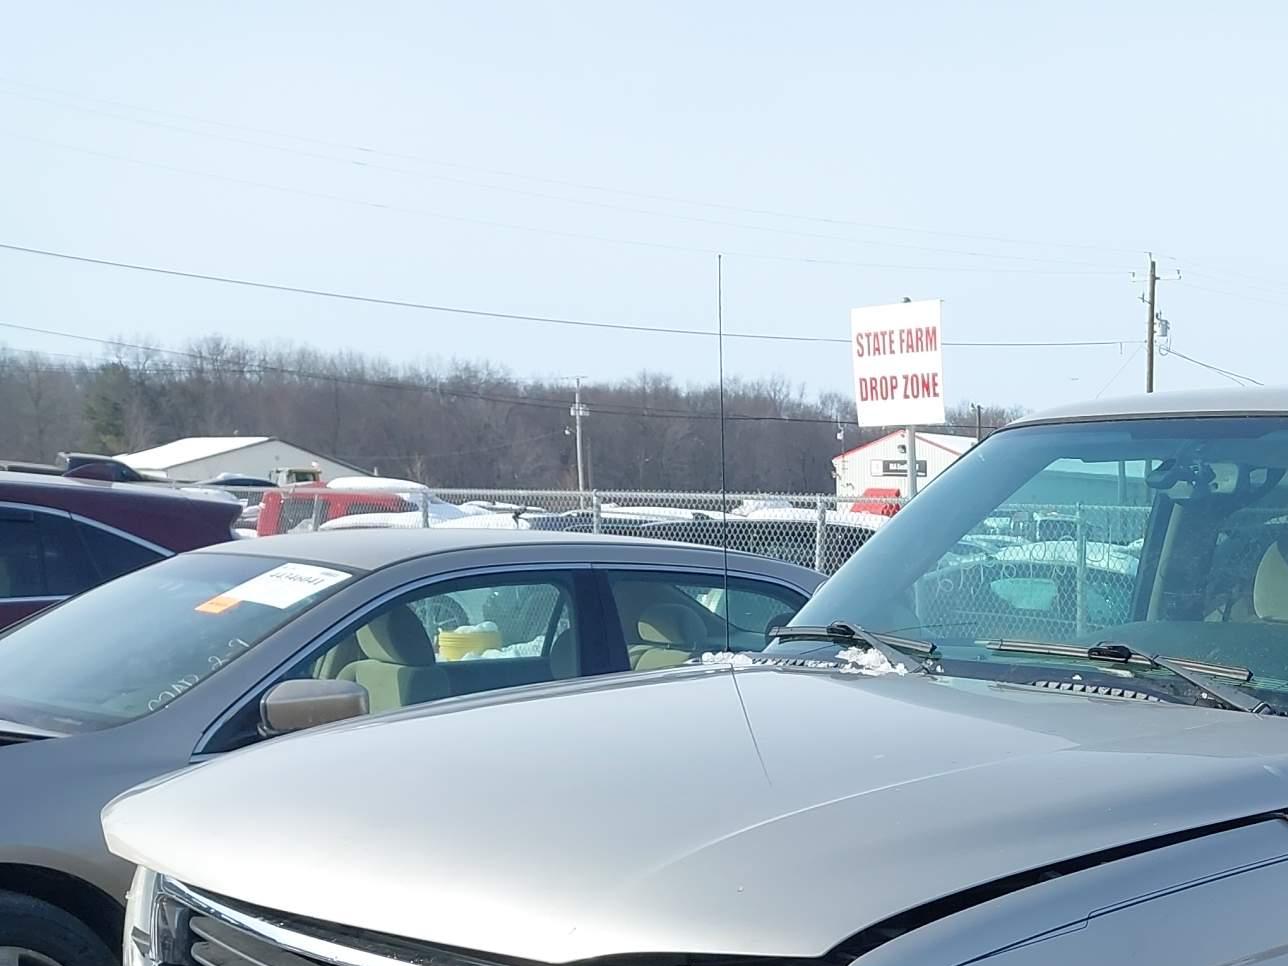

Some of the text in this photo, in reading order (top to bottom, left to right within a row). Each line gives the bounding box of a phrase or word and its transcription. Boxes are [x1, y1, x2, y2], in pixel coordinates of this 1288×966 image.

[856, 326, 938, 358] STATE FARM
[859, 372, 940, 402] DROP ZONE
